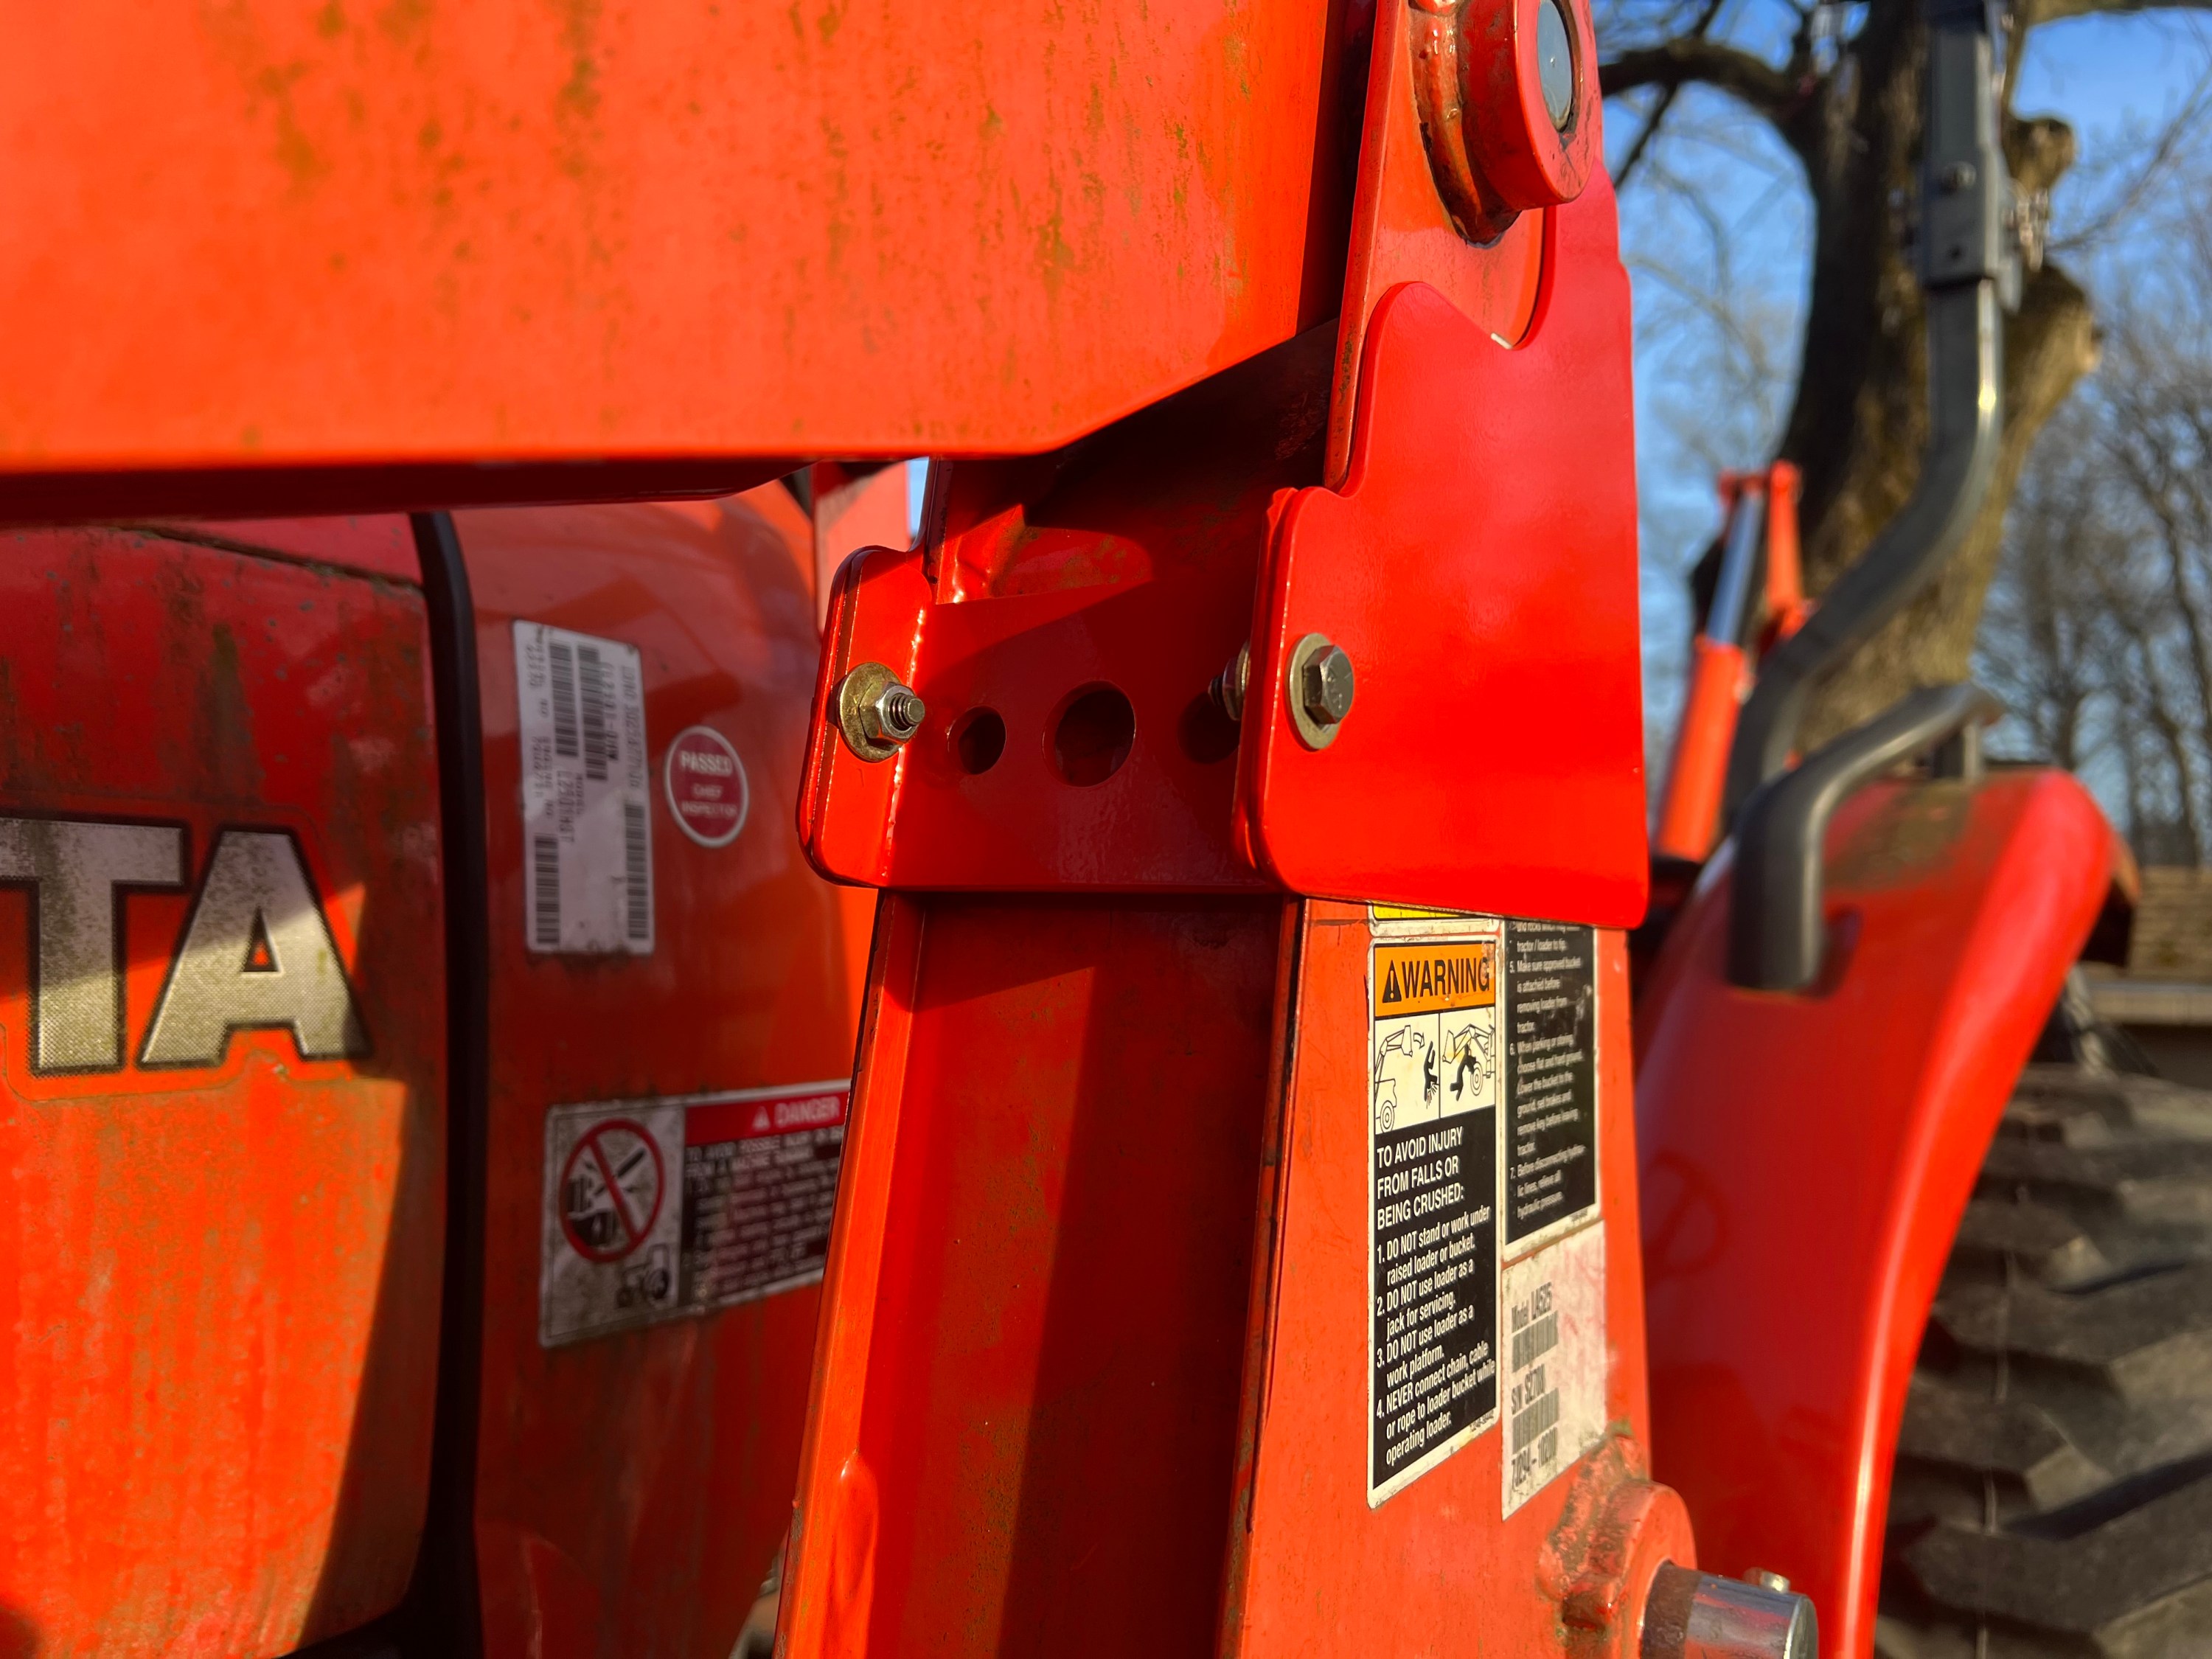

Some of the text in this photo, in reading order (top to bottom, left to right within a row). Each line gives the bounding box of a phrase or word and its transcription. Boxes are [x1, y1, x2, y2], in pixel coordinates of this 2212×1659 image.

[680, 750, 733, 776] PASSED
[1402, 958, 1490, 999] WARNING
[1377, 1126, 1464, 1169] TO AVOID INJURY
[1377, 1155, 1459, 1200] FROM FALLS OR
[1377, 1182, 1464, 1231] BEING CRUSHED:
[1377, 1205, 1491, 1264] 1. DO NOT stand or work under
[1387, 1232, 1475, 1287] raised loader or bucket.
[1377, 1258, 1474, 1316] 2. DO NOT use loader as a
[1377, 1304, 1475, 1368] 3. DO NOT use loader as a
[1387, 1290, 1456, 1342] jack for servicing.
[1376, 1340, 1489, 1419] 4. NEVER connect chain, cable
[1386, 1344, 1444, 1388] work platform.
[1386, 1358, 1496, 1439] or rope to loader bucket while
[1386, 1425, 1425, 1467] operating
[1426, 1411, 1453, 1440] loader.
